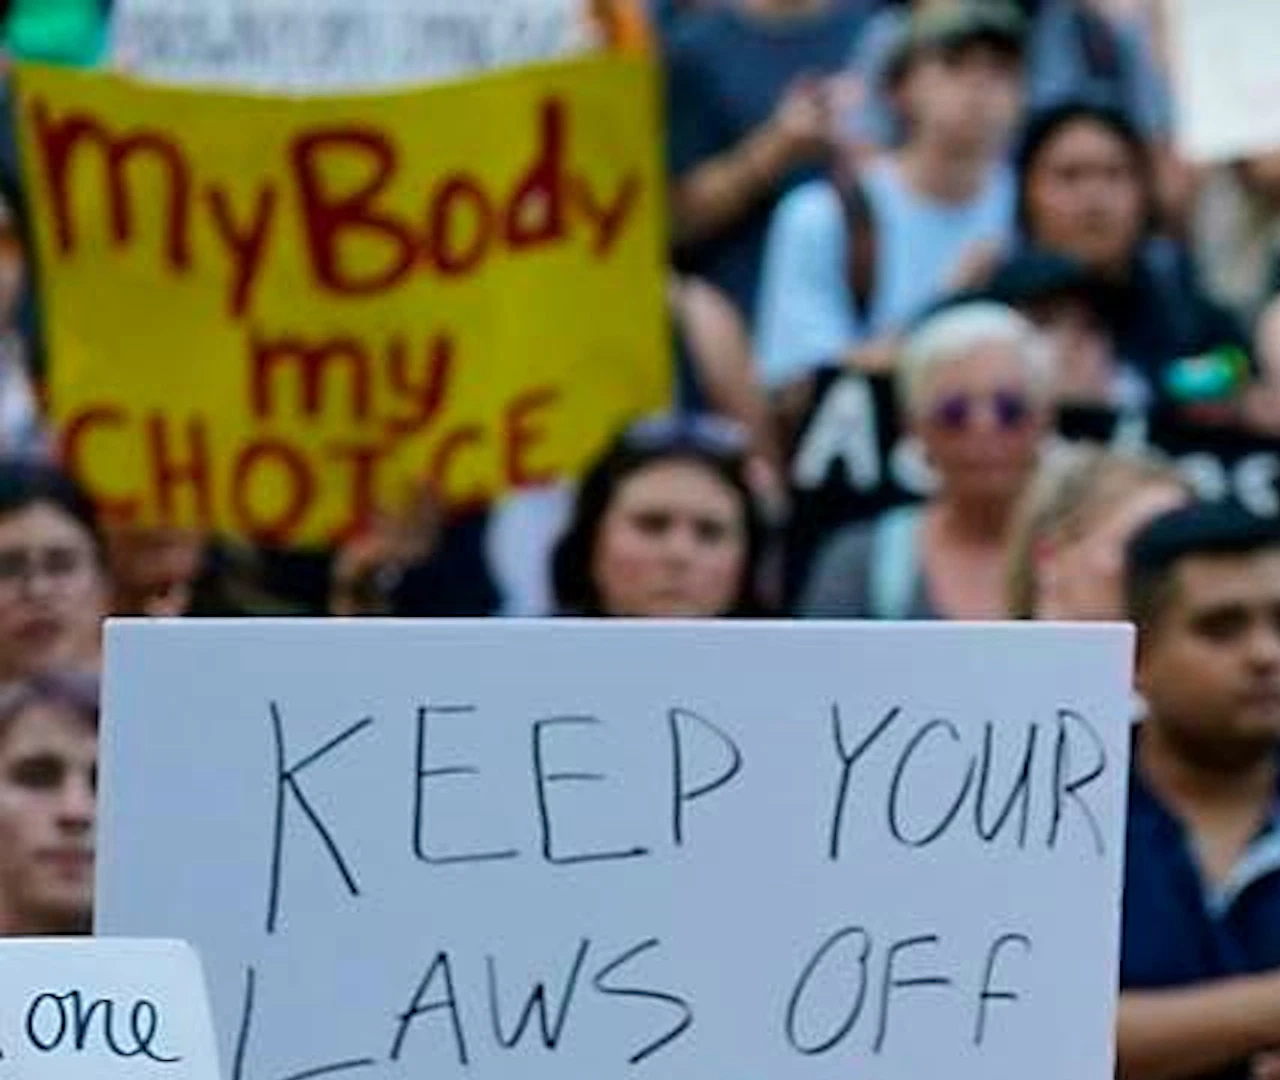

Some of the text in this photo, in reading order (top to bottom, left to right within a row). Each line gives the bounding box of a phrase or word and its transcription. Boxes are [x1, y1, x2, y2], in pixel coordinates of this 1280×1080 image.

[289, 93, 645, 295] Body
[60, 387, 567, 546] CHOICE
[265, 698, 1106, 934] KEEP YOUR
[25, 988, 183, 1063] one
